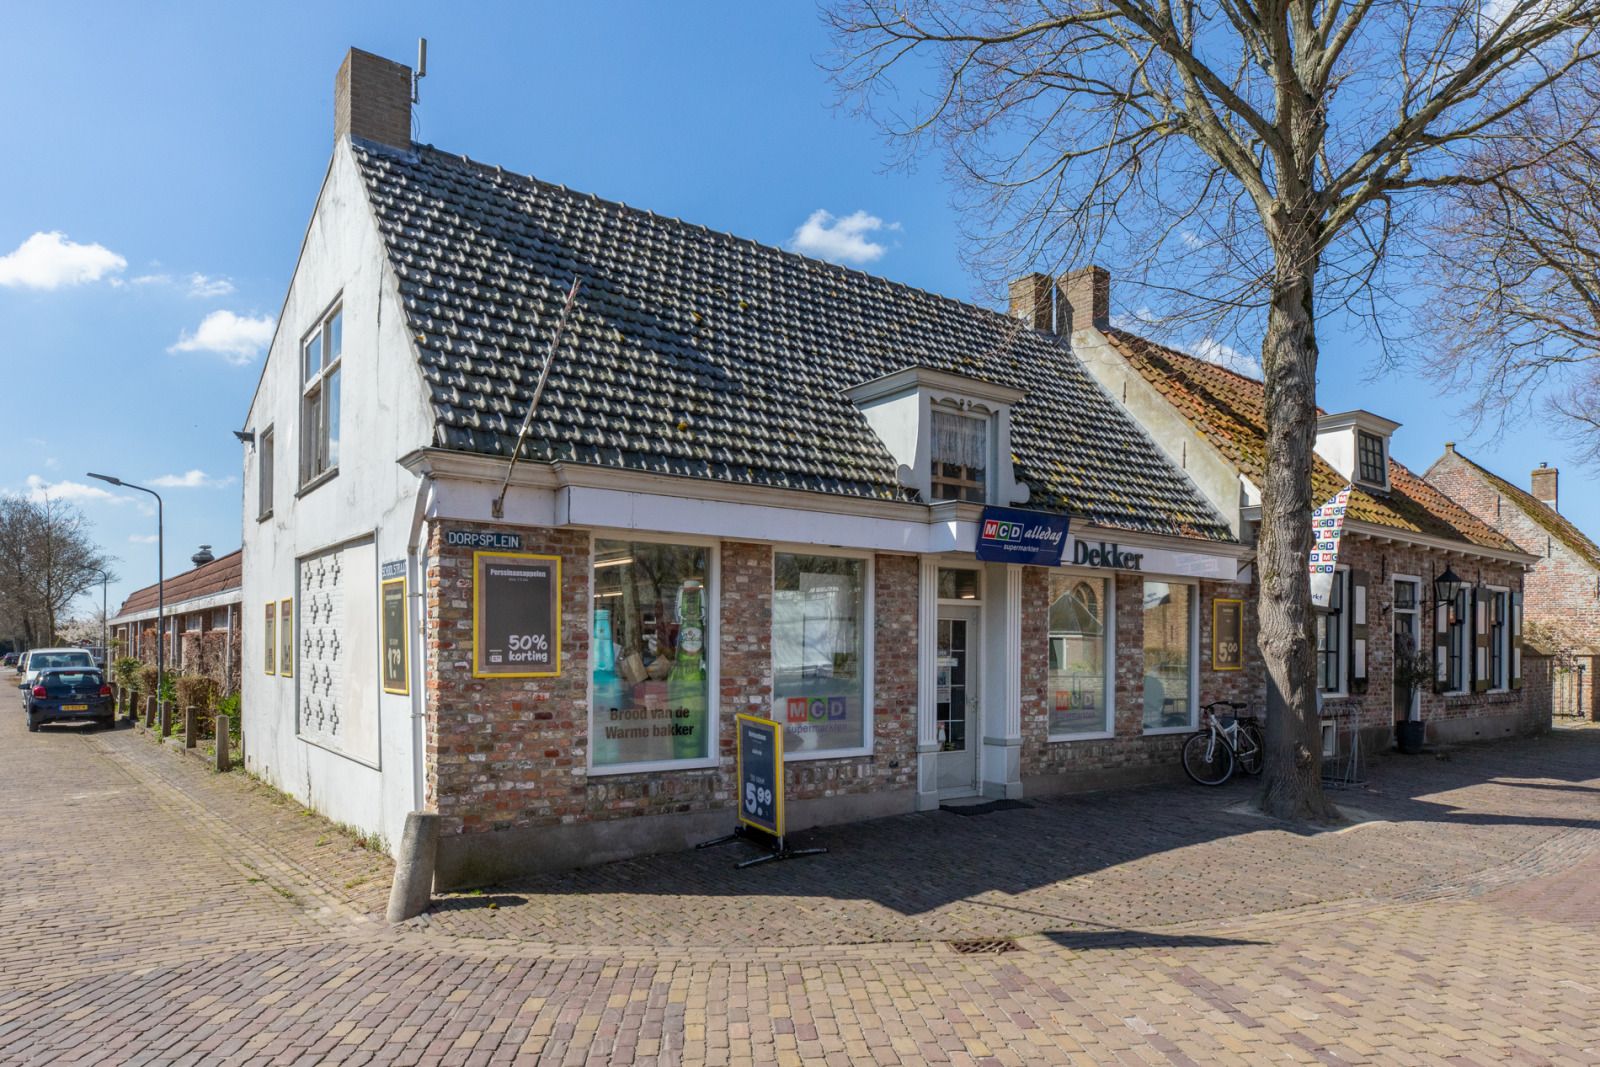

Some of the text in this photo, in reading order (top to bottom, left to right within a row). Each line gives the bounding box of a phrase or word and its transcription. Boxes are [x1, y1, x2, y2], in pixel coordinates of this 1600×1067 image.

[448, 531, 519, 548] DORPSPLEIN
[985, 521, 1063, 545] MCD alledag
[1073, 539, 1143, 570] Dekker
[508, 634, 548, 650] 50%
[508, 650, 548, 662] korting
[610, 706, 690, 721] Brood van de
[789, 699, 844, 720] MCD
[605, 723, 694, 739] Warme bakker
[745, 782, 772, 816] 5.99
